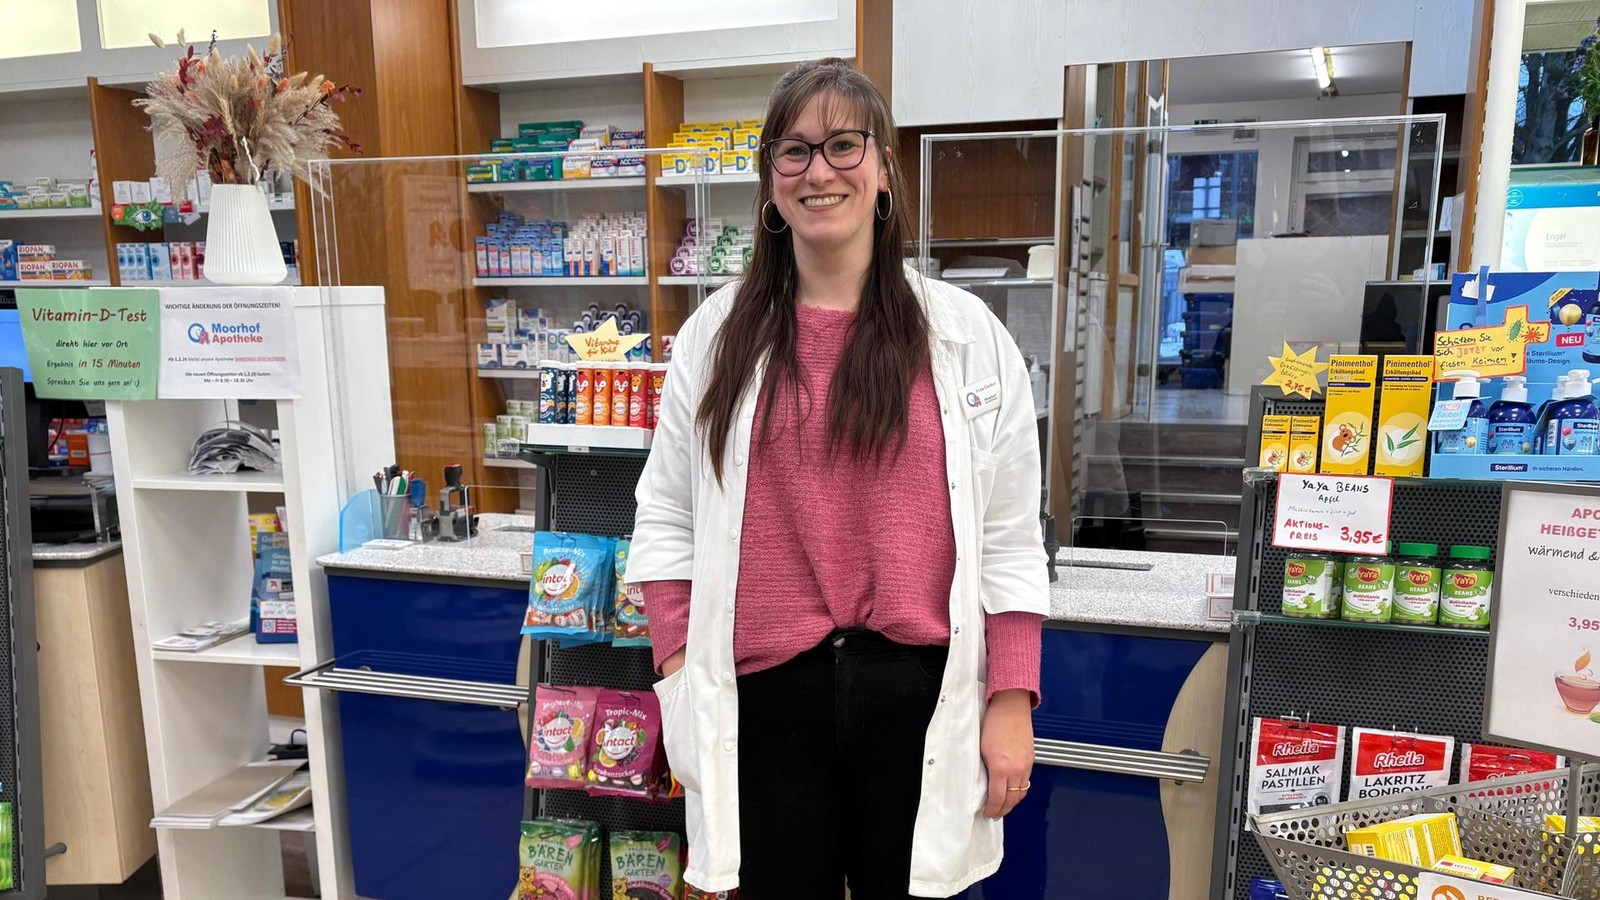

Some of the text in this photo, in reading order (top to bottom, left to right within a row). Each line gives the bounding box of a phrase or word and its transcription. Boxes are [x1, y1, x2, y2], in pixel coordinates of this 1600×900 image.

[748, 134, 758, 150] D
[675, 158, 686, 174] D
[705, 157, 714, 172] D
[736, 156, 746, 171] D
[1546, 232, 1567, 242] Engel
[32, 307, 147, 322] Vitamin-D-Test
[212, 322, 260, 333] Moorhof
[56, 340, 79, 348] direkt
[212, 334, 263, 345] Apotheke
[1437, 333, 1492, 346] Schützen Sie
[1561, 336, 1582, 344] NEU
[1456, 346, 1487, 358] JETZT
[47, 359, 141, 369] Ergebnis in 15 Minuten
[47, 377, 76, 386] Sprechen
[79, 378, 90, 386] Sie
[1336, 481, 1369, 493] BEANS
[1318, 494, 1340, 504] Apfel
[1290, 531, 1318, 541] PREIS
[1340, 526, 1383, 544] 3,95€
[1540, 524, 1600, 539] HEIßGE
[1528, 545, 1600, 561] wärmend &
[1568, 617, 1600, 631] 3,95
[605, 708, 647, 721] Tropic-Mix
[544, 726, 572, 736] intact
[603, 736, 636, 747] intact
[1272, 740, 1319, 757] Rheila
[1374, 752, 1424, 768] Rheila
[1266, 765, 1320, 778] SALMIAK
[1262, 776, 1326, 789] PASTILLEN
[1365, 774, 1426, 787] LAKRITZ
[528, 844, 574, 866] BÄREN
[616, 853, 666, 870] BÄREN
[534, 859, 566, 871] GARTEN
[624, 868, 656, 877] GARTEN
